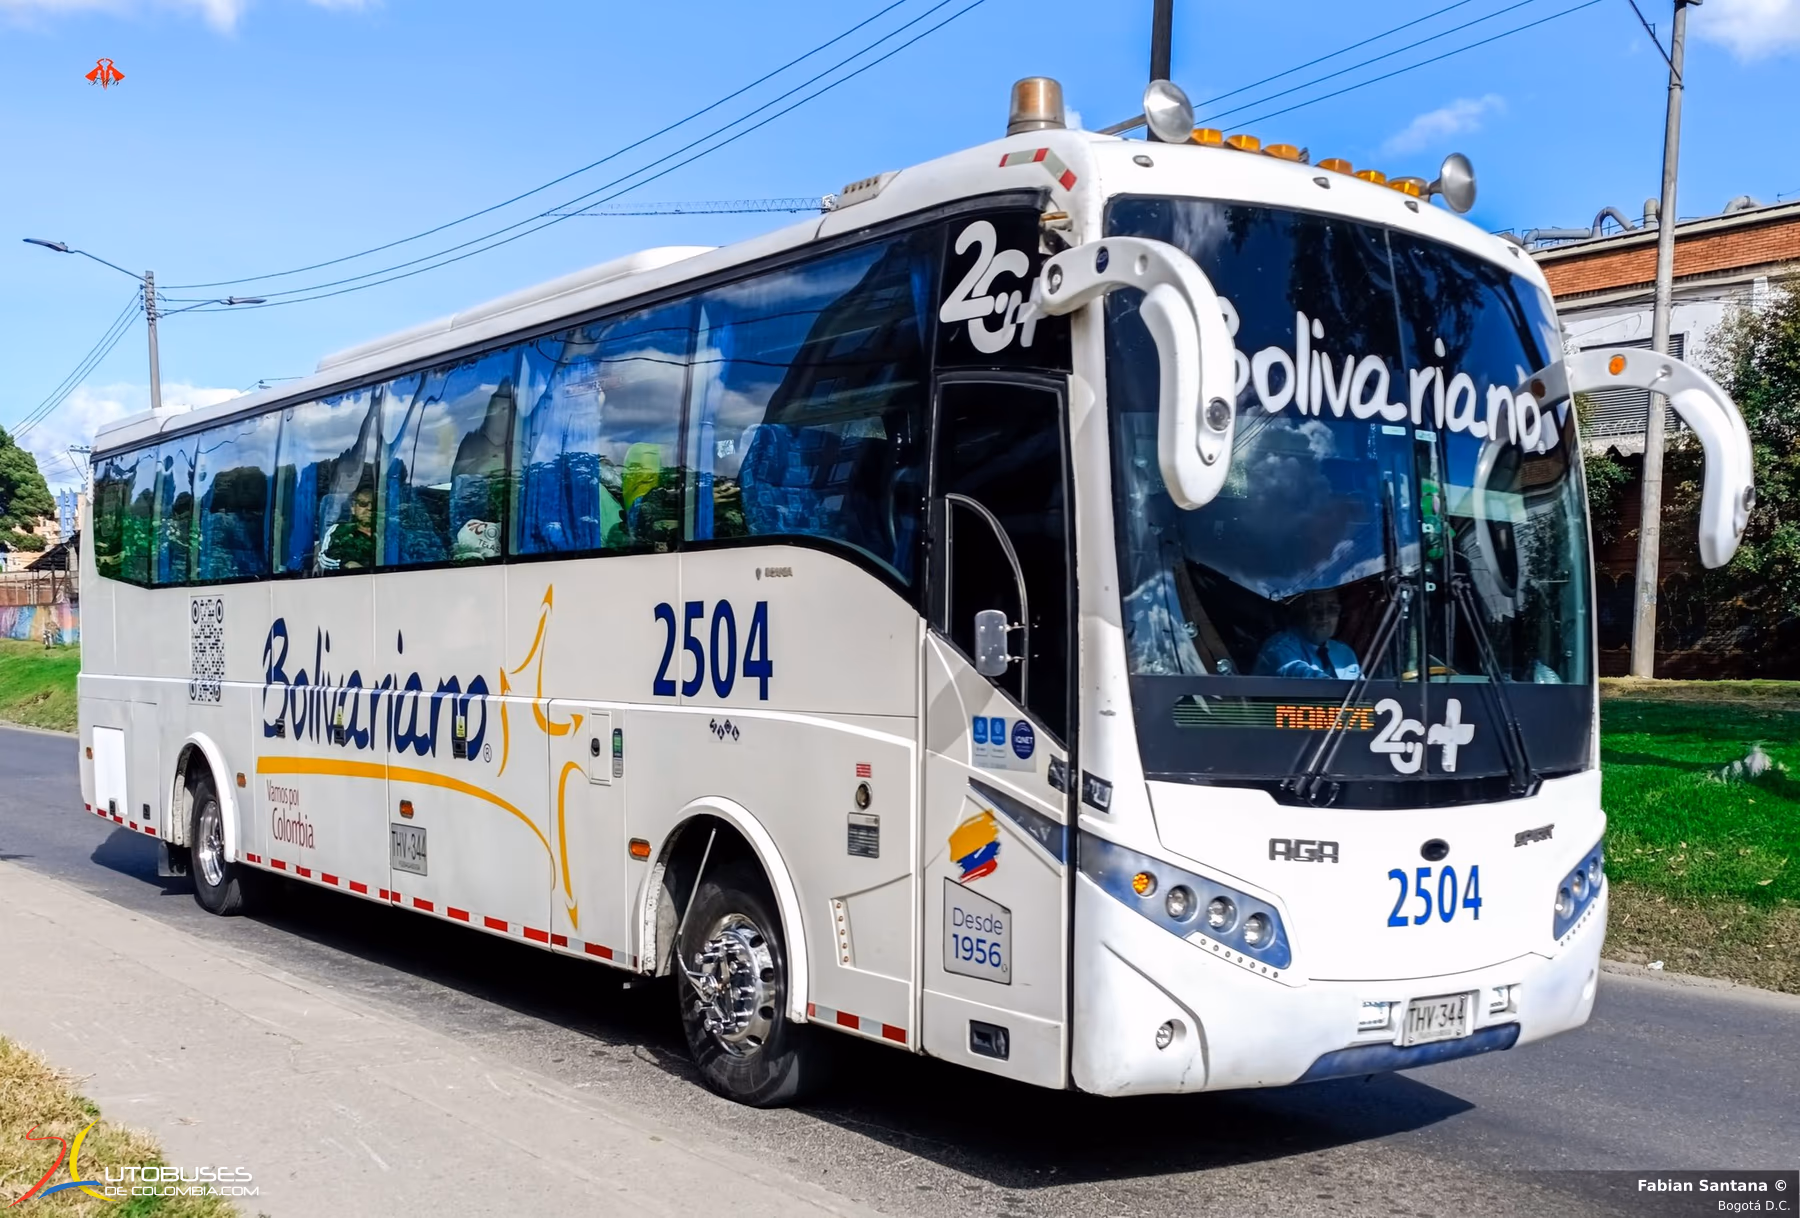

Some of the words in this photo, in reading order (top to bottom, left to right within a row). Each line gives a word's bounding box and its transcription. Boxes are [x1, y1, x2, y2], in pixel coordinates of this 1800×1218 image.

[653, 599, 773, 701] 2504
[266, 779, 288, 804] Vamos
[272, 807, 314, 849] Colombia
[1269, 838, 1339, 863] AGA
[1387, 865, 1482, 927] 2504
[952, 907, 1003, 936] Desde
[952, 933, 1002, 968] 1956
